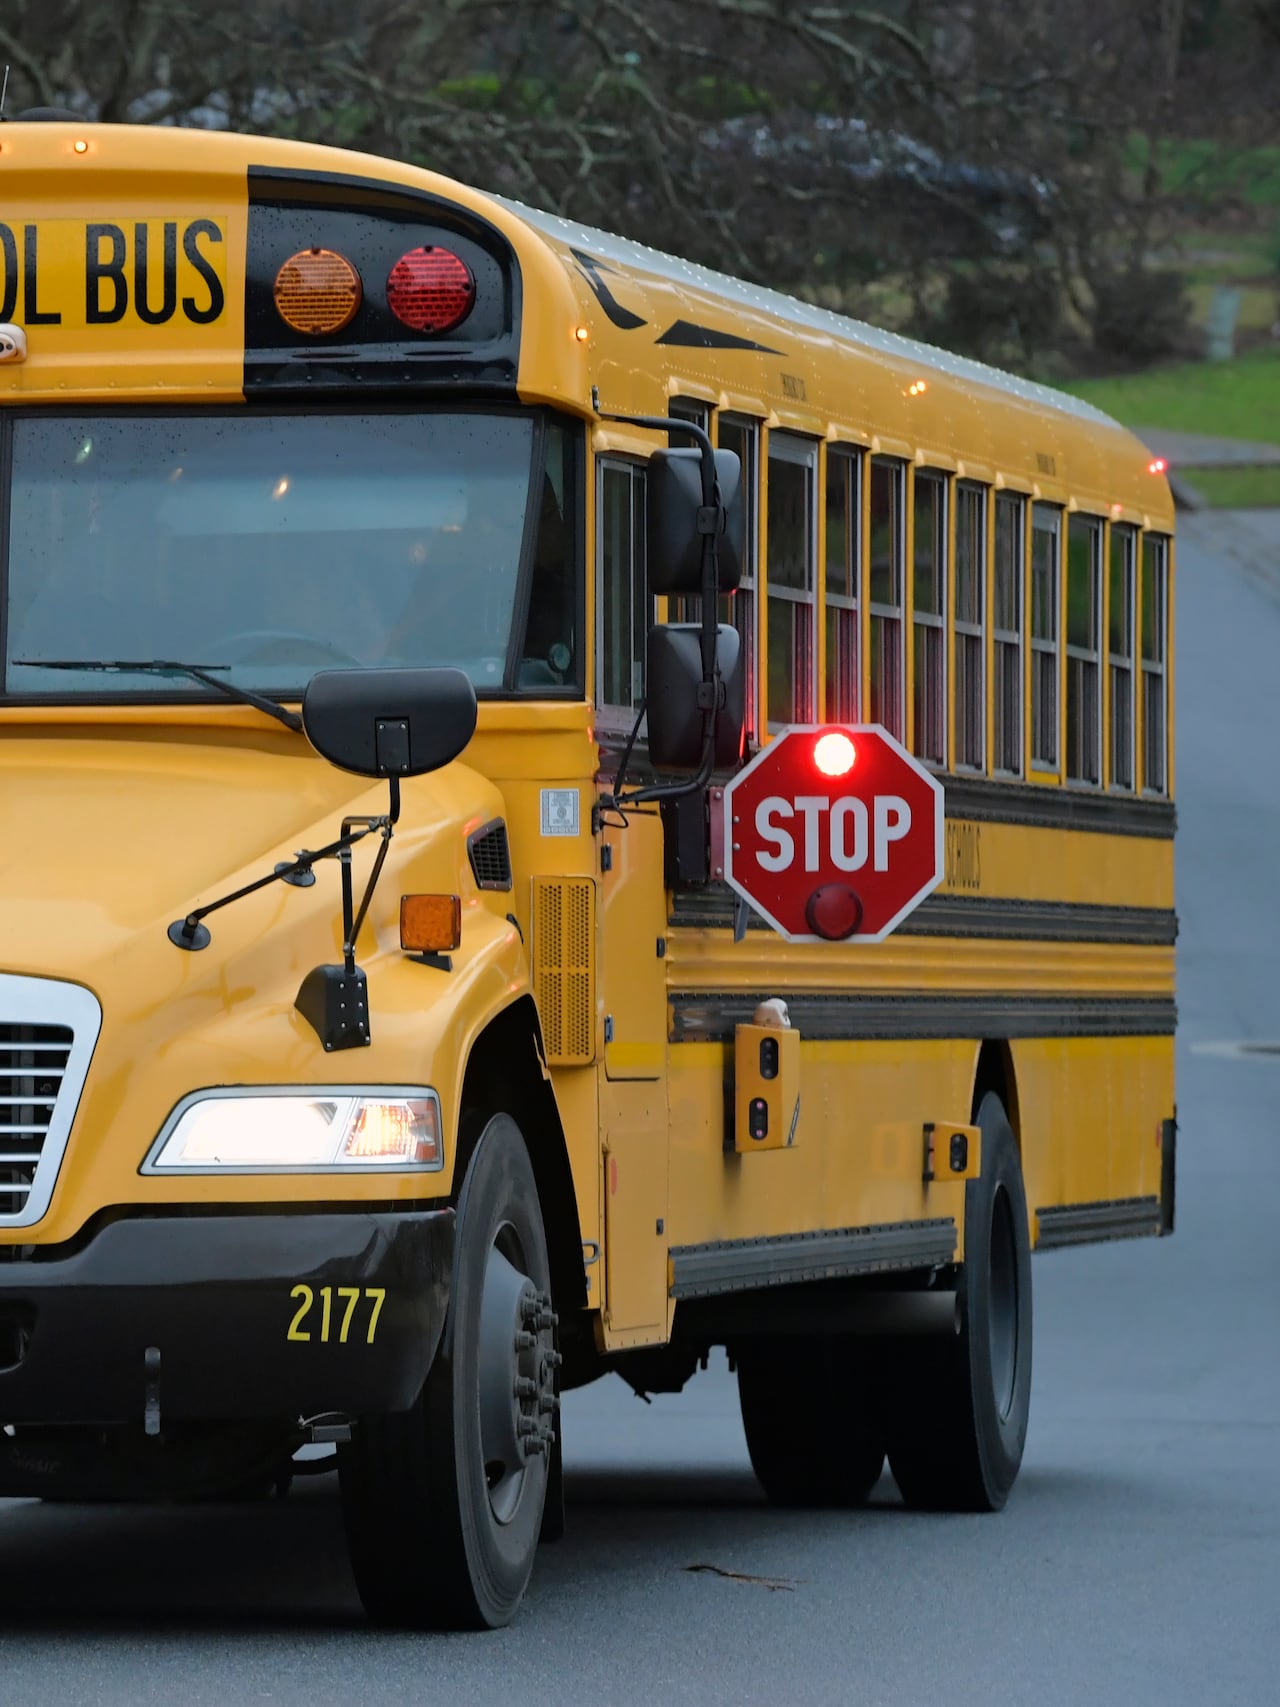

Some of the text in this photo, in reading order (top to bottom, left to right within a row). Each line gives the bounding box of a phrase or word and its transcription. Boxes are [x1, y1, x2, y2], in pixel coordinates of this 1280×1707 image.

[84, 218, 225, 326] BUS
[754, 795, 912, 873] STOP
[286, 1283, 387, 1344] 2177
